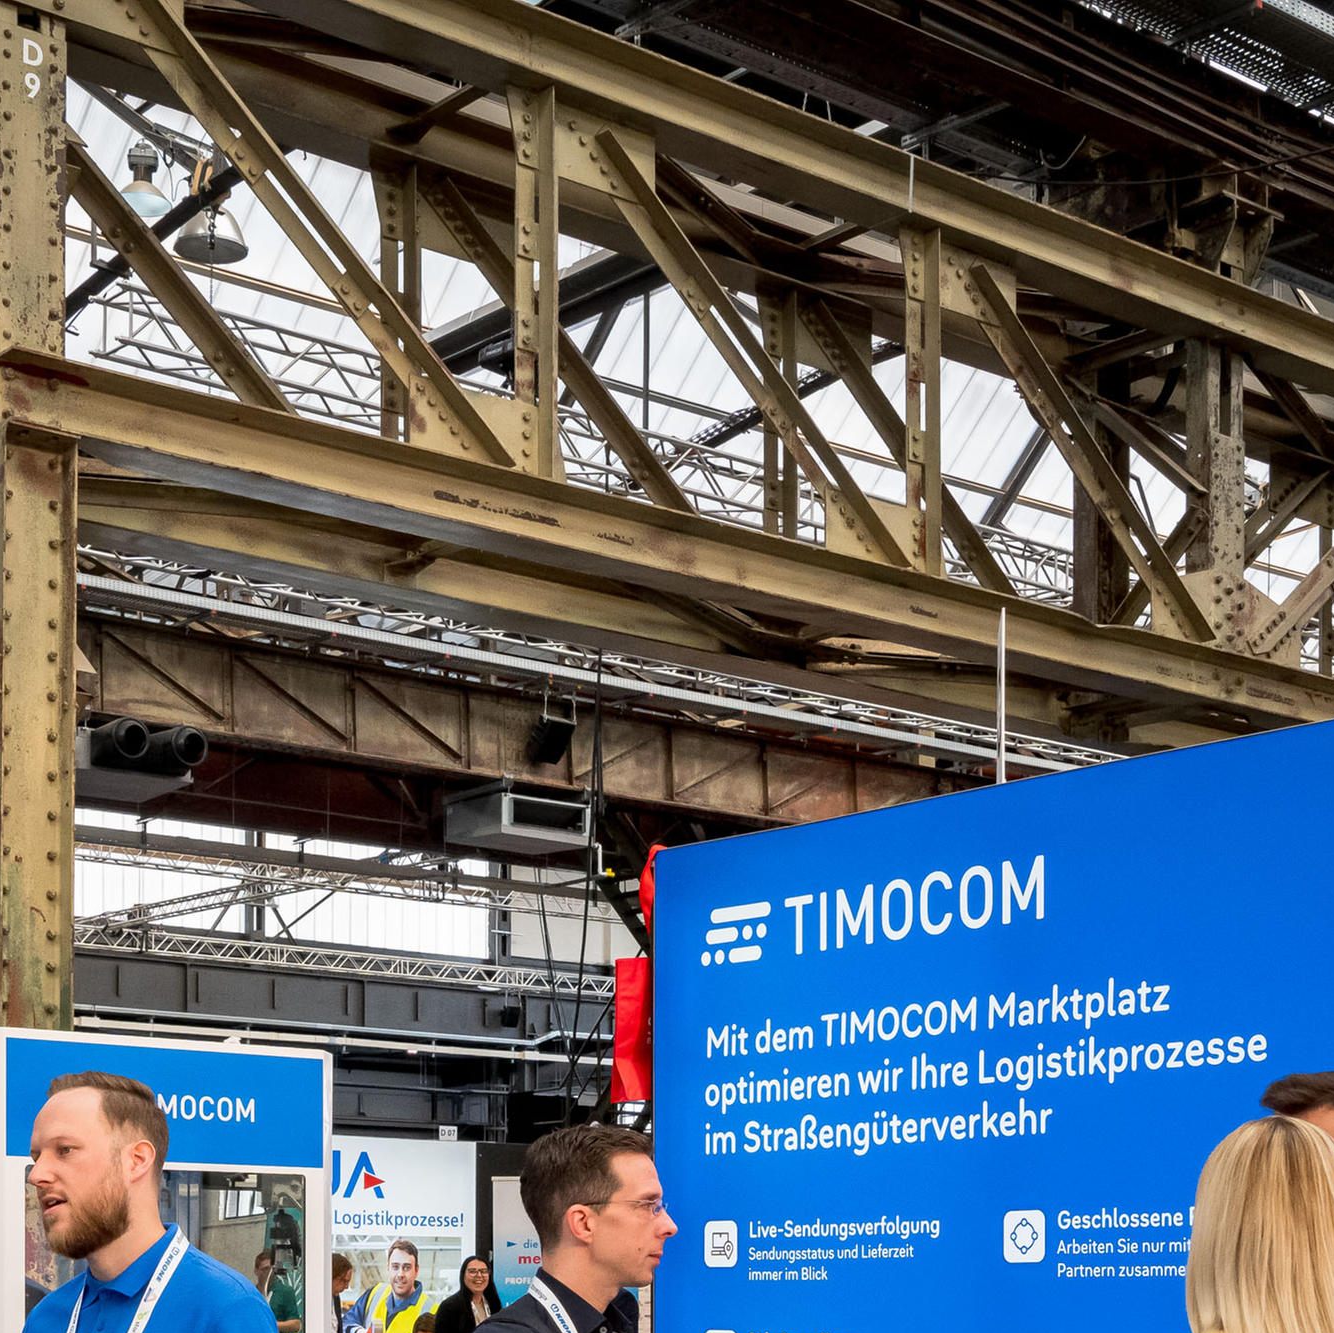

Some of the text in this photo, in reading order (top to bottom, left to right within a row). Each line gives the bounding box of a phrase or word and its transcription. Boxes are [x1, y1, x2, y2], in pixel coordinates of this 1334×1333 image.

[784, 854, 1045, 955] TIMOCOM
[707, 977, 1170, 1058] Mit dem TIMOCOM Marktplatz
[705, 1034, 1267, 1115] optimieren wir Ihre Logistikprozesse
[440, 1128, 446, 1137] D
[705, 1097, 1053, 1156] im Straßengüterverkehr
[334, 1209, 464, 1230] Logistikprozesse!
[749, 1215, 940, 1241] Live-Sendungsverfolgung
[1057, 1207, 1184, 1230] Geschlossene
[523, 1239, 538, 1249] die
[748, 1243, 914, 1264] Sendungsstatus und Lieferzeit
[1057, 1238, 1114, 1255] Arbeiten
[1117, 1237, 1138, 1254] Sie
[1142, 1240, 1165, 1253] nur
[156, 1253, 174, 1283] KRONE
[748, 1266, 828, 1281] immer im Blick
[1057, 1262, 1115, 1278] Partnern
